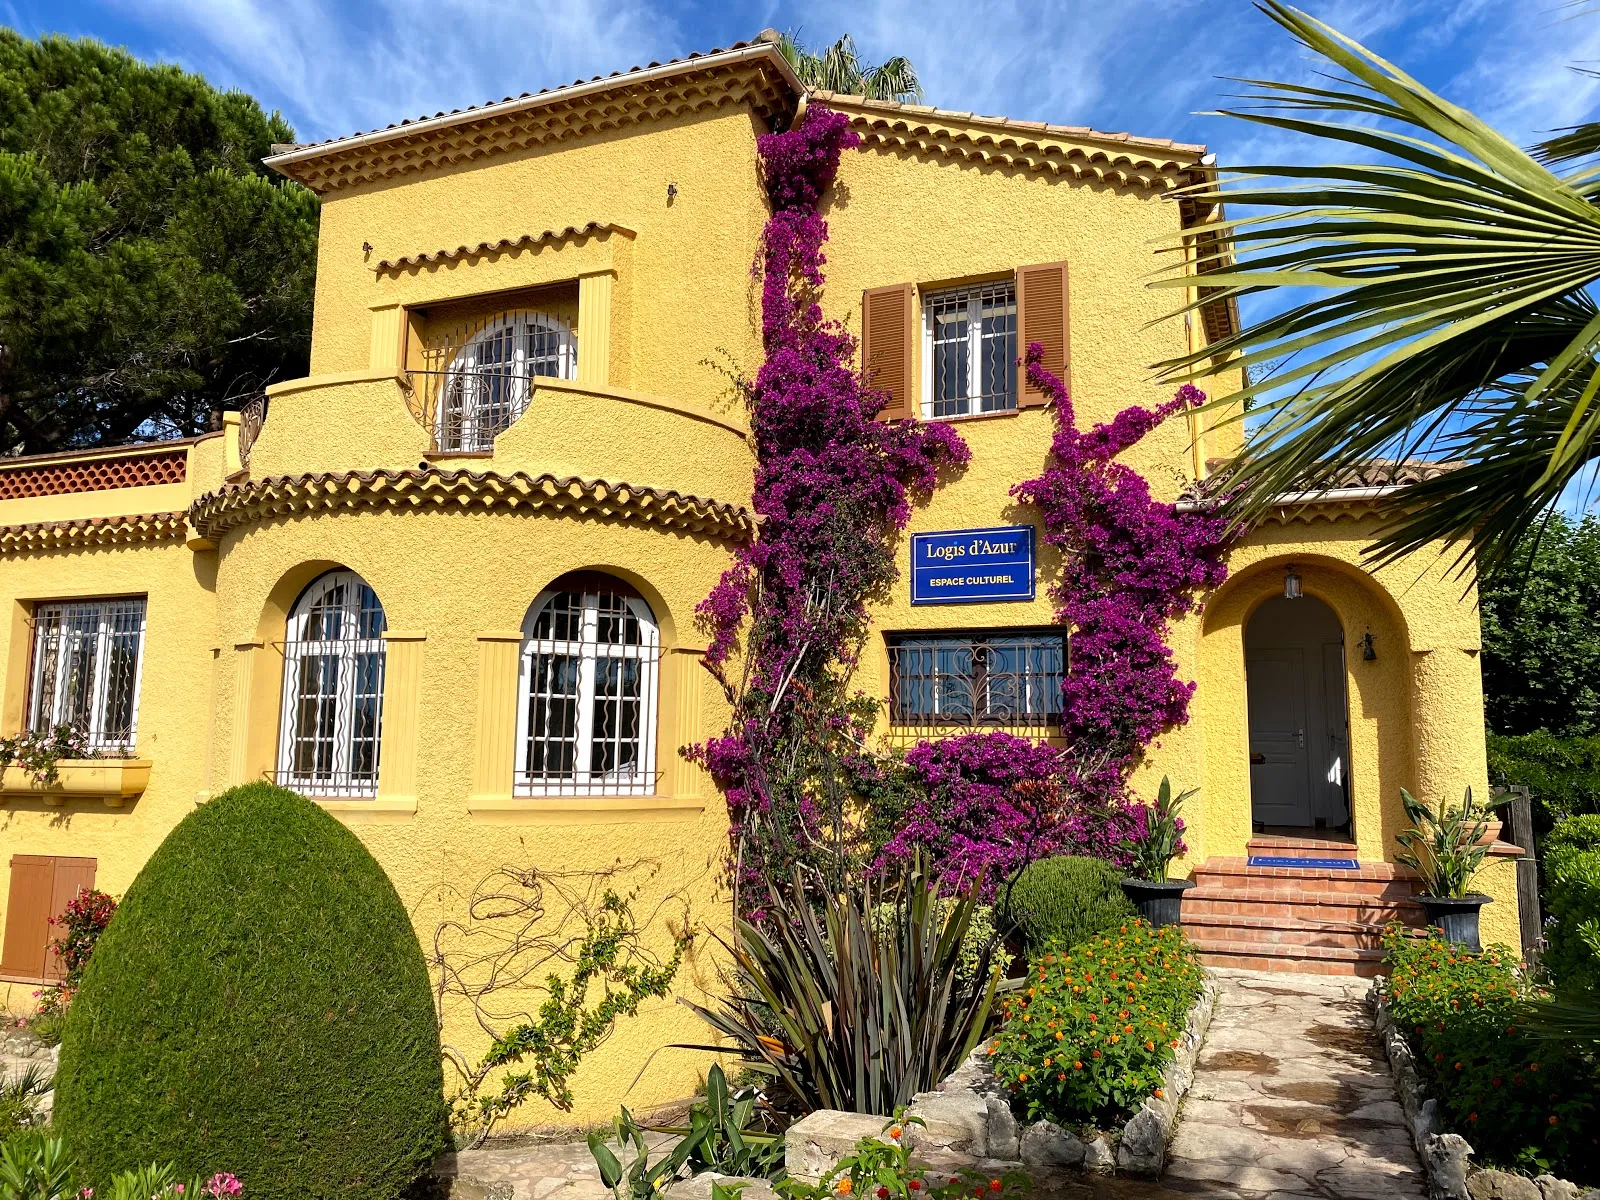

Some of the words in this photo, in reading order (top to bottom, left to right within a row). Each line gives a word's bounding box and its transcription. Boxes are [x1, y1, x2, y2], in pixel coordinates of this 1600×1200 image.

[926, 541, 966, 560] Logis
[969, 540, 1017, 556] d'Azur
[930, 578, 965, 586] ESPACE
[966, 575, 1014, 585] CULTUREL
